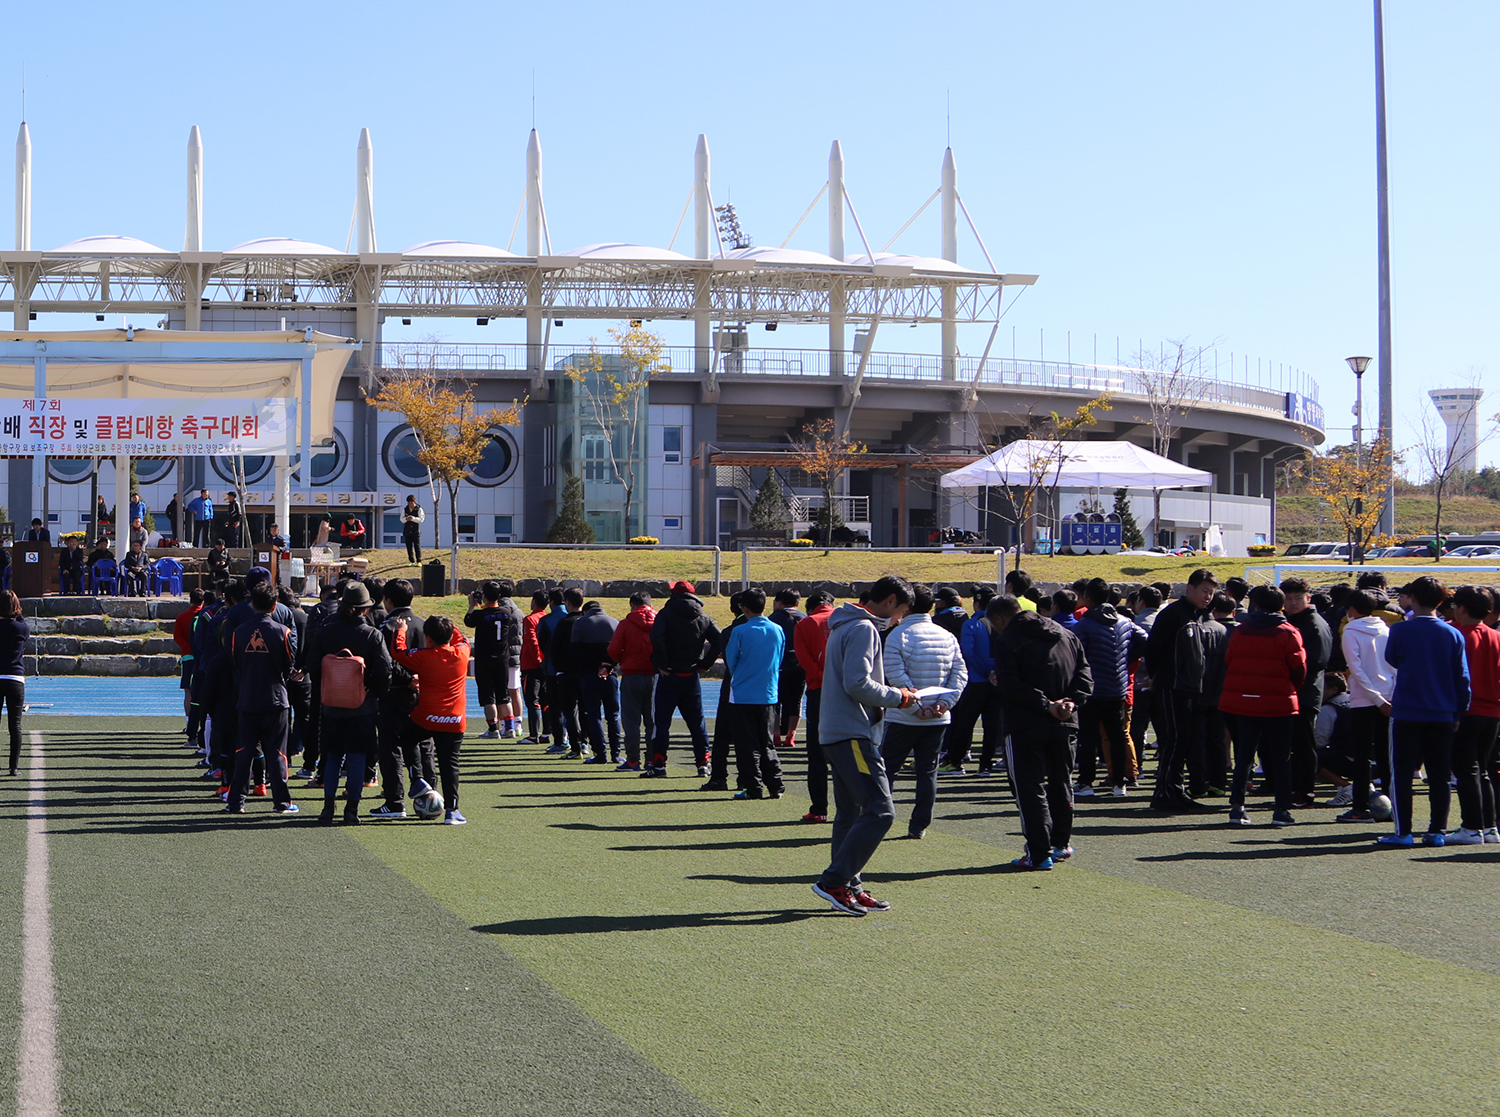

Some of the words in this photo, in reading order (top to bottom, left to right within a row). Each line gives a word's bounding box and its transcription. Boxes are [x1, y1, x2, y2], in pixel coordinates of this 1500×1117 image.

[28, 415, 67, 440] 직장
[74, 418, 88, 440] 및
[94, 415, 174, 440] 클럽대항
[180, 414, 259, 440] 축구대회
[494, 620, 502, 640] 1
[425, 714, 463, 724] rennen
